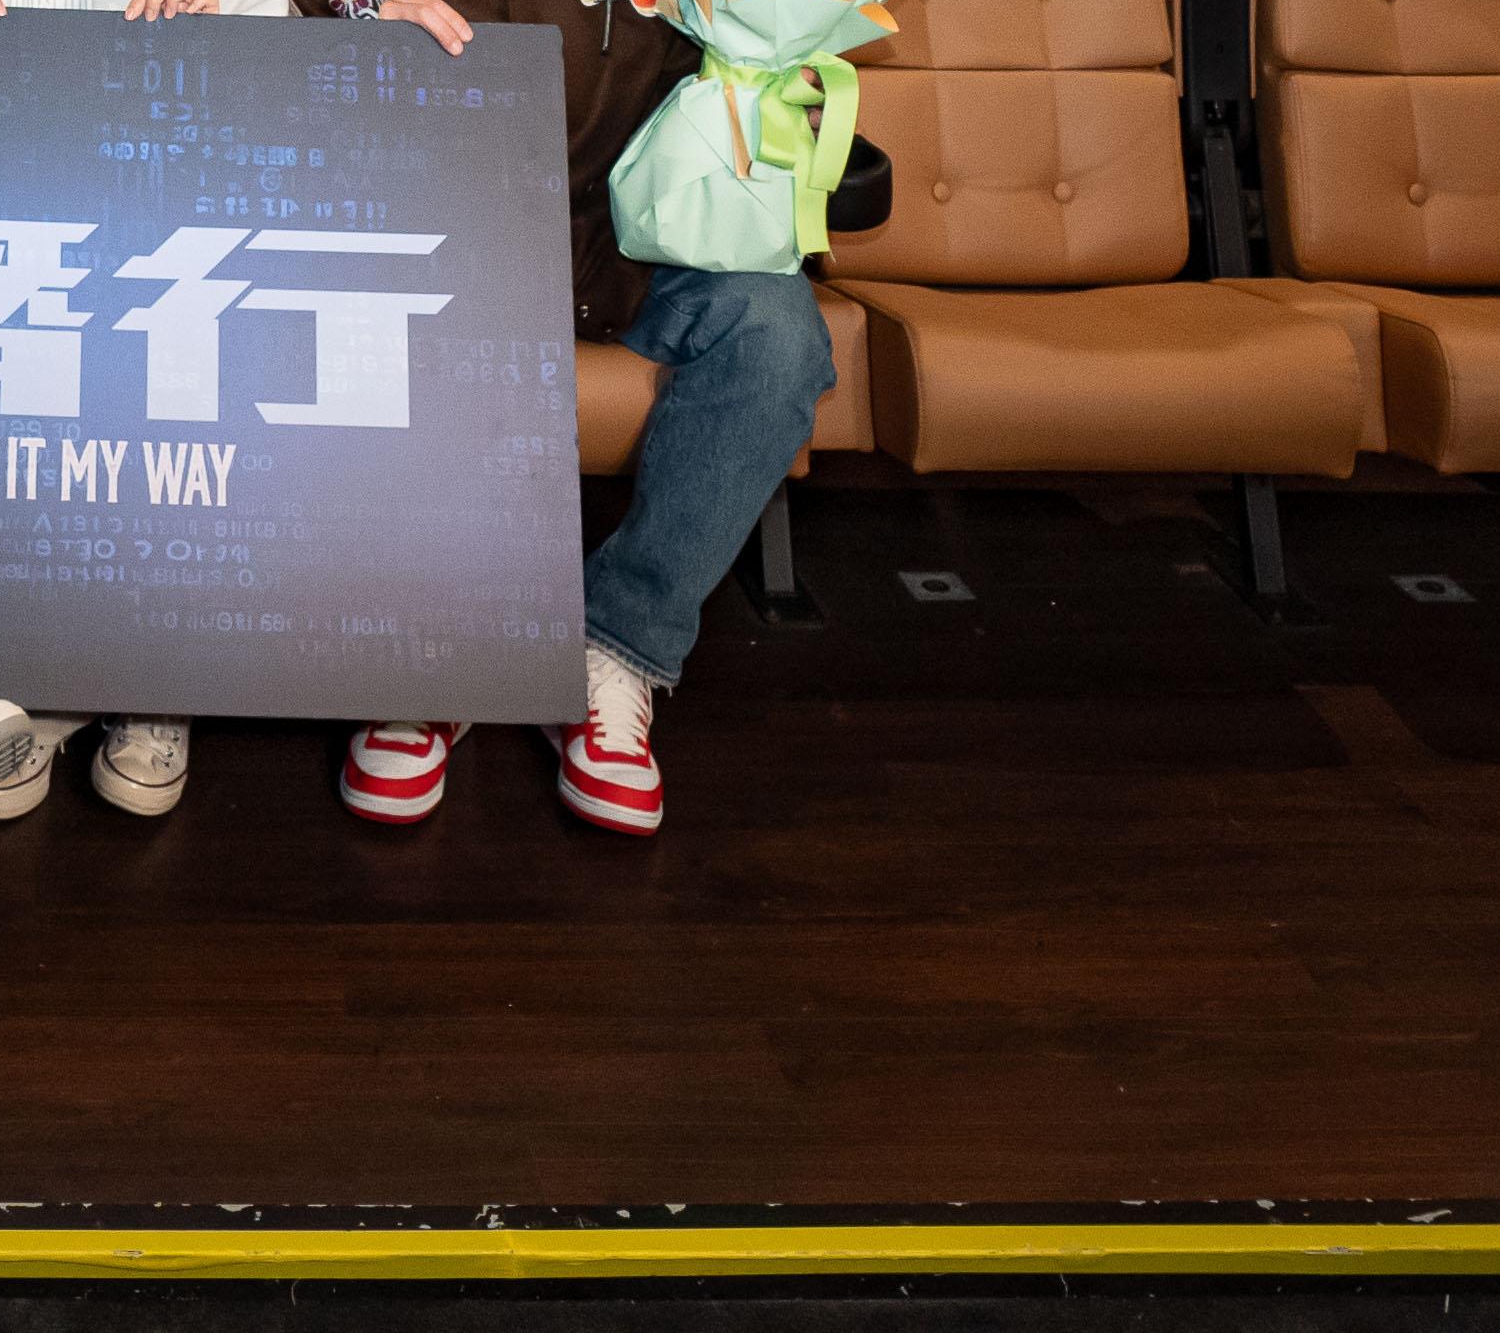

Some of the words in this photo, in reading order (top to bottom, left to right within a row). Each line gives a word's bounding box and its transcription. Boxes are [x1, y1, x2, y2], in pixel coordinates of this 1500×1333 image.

[7, 437, 47, 501] IT
[61, 439, 129, 504] MY
[143, 442, 237, 507] WAY
